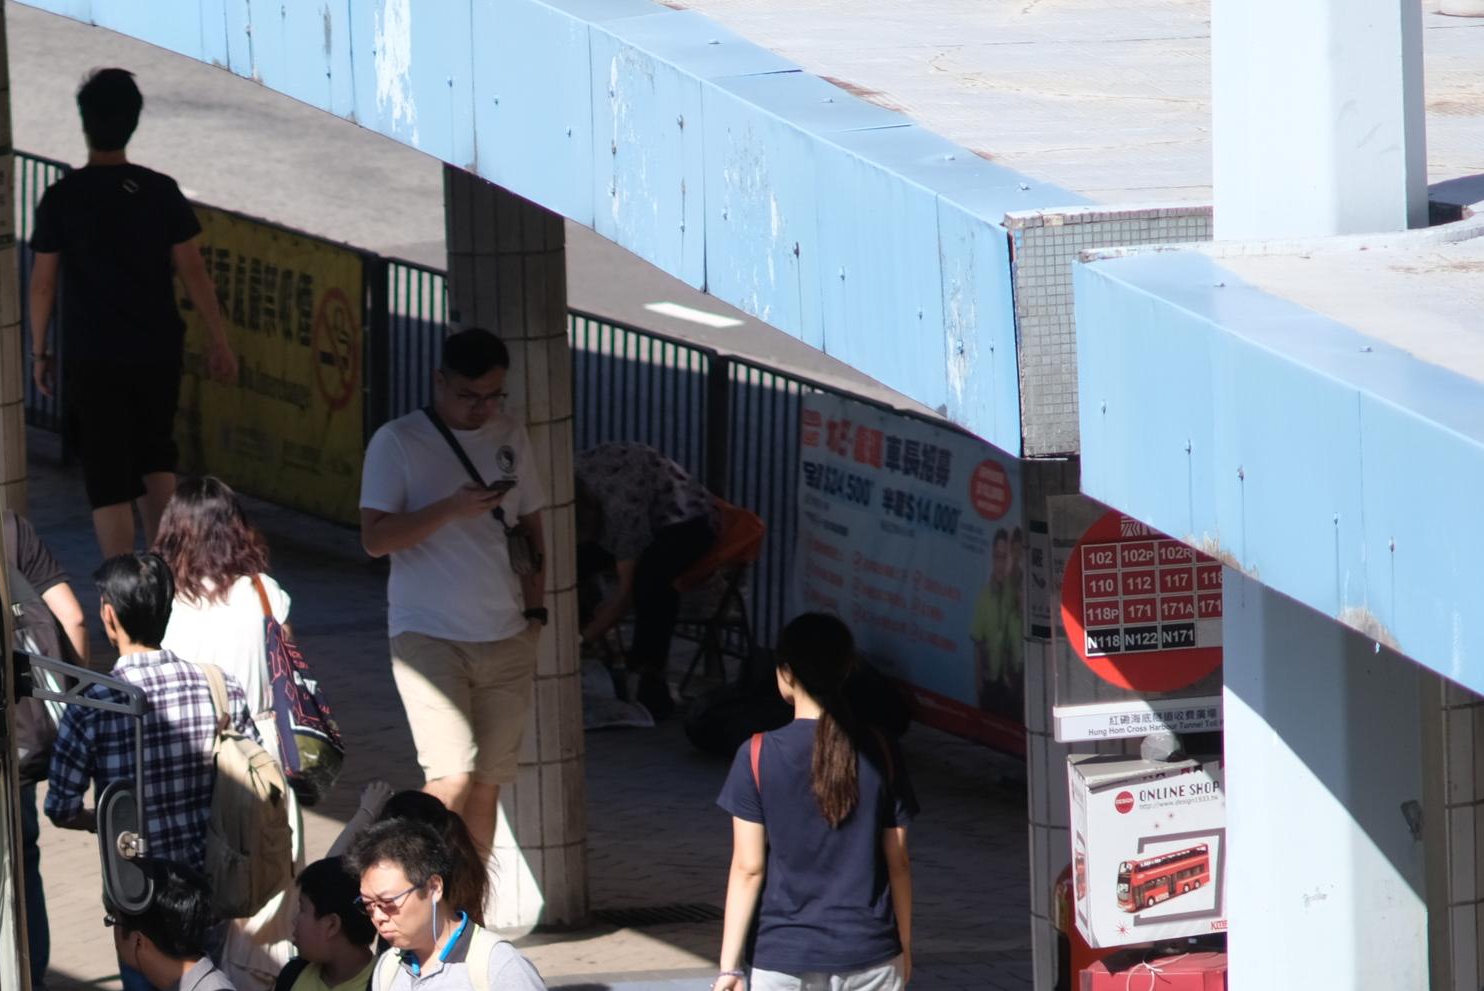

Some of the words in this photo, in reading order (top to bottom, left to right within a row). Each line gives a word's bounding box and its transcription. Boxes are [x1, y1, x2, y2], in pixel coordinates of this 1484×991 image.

[1088, 552, 1113, 565] 102
[1123, 550, 1154, 563] 102P
[1090, 579, 1114, 593] 110
[1127, 577, 1152, 590] 112
[1165, 574, 1189, 588] 117
[1087, 607, 1119, 621] 118P
[1128, 605, 1152, 618] 171
[1162, 602, 1195, 616] 171A
[1087, 635, 1120, 649] N118
[1125, 632, 1158, 646] N122
[1162, 629, 1194, 644] N171
[1088, 728, 1108, 737] Hung
[1127, 725, 1148, 734] Cross
[1139, 784, 1186, 802] ONLINE
[1189, 780, 1220, 795] SHOP
